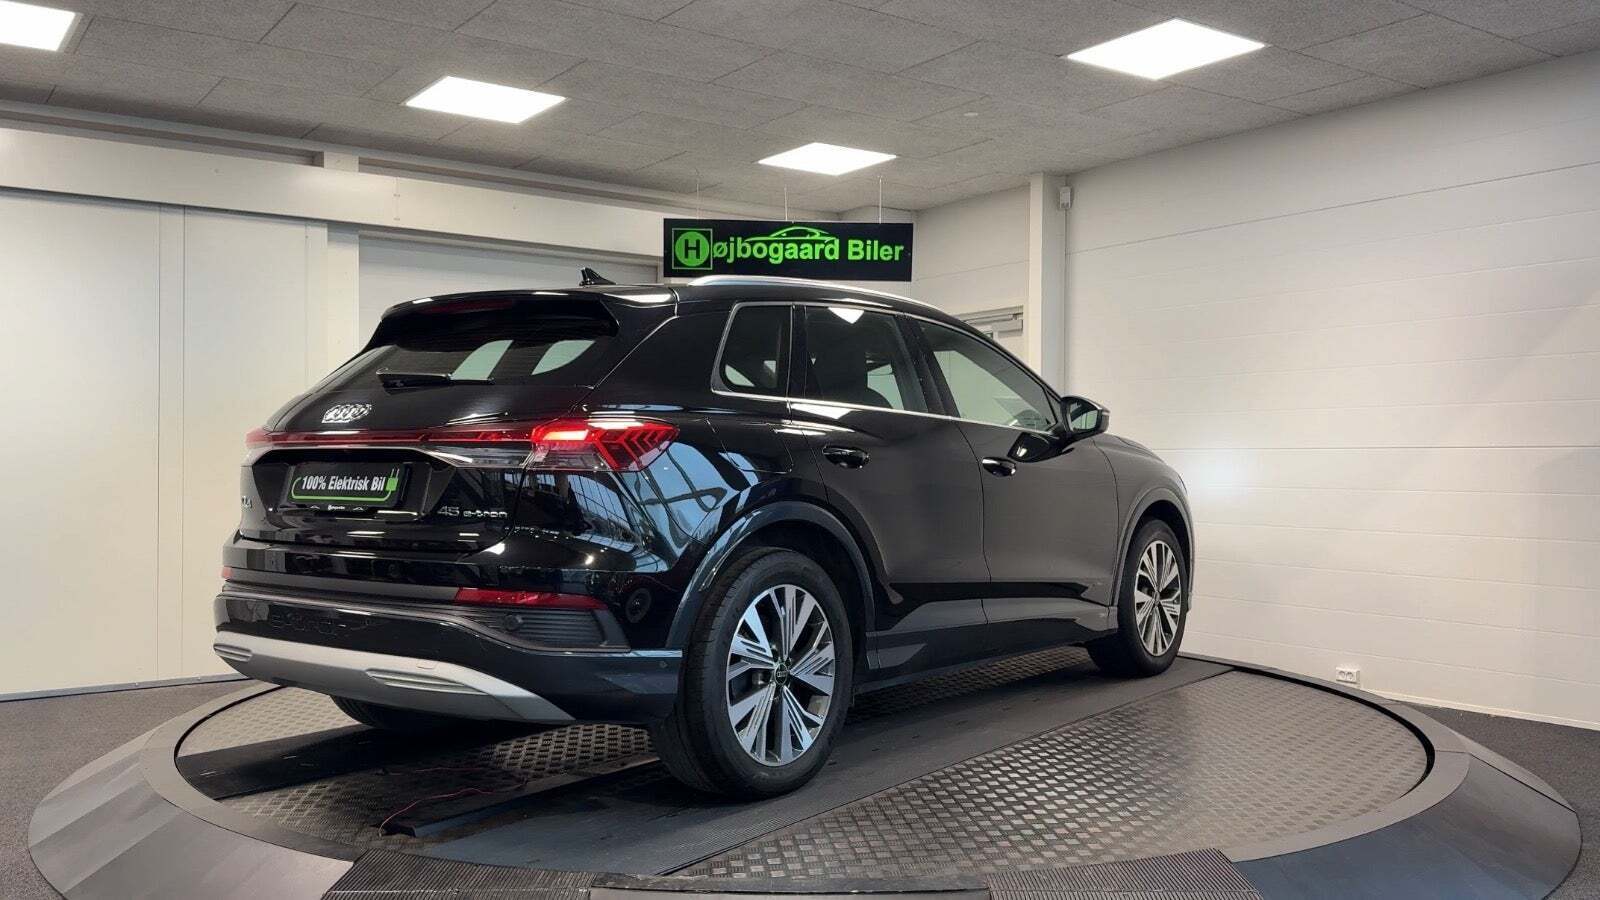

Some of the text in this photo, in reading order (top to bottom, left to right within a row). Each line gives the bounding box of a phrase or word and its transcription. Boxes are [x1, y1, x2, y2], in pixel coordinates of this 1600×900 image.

[848, 239, 904, 261] Biler
[301, 475, 386, 491] 100% Elektrisk Bil
[437, 505, 508, 518] 45 e-tron
